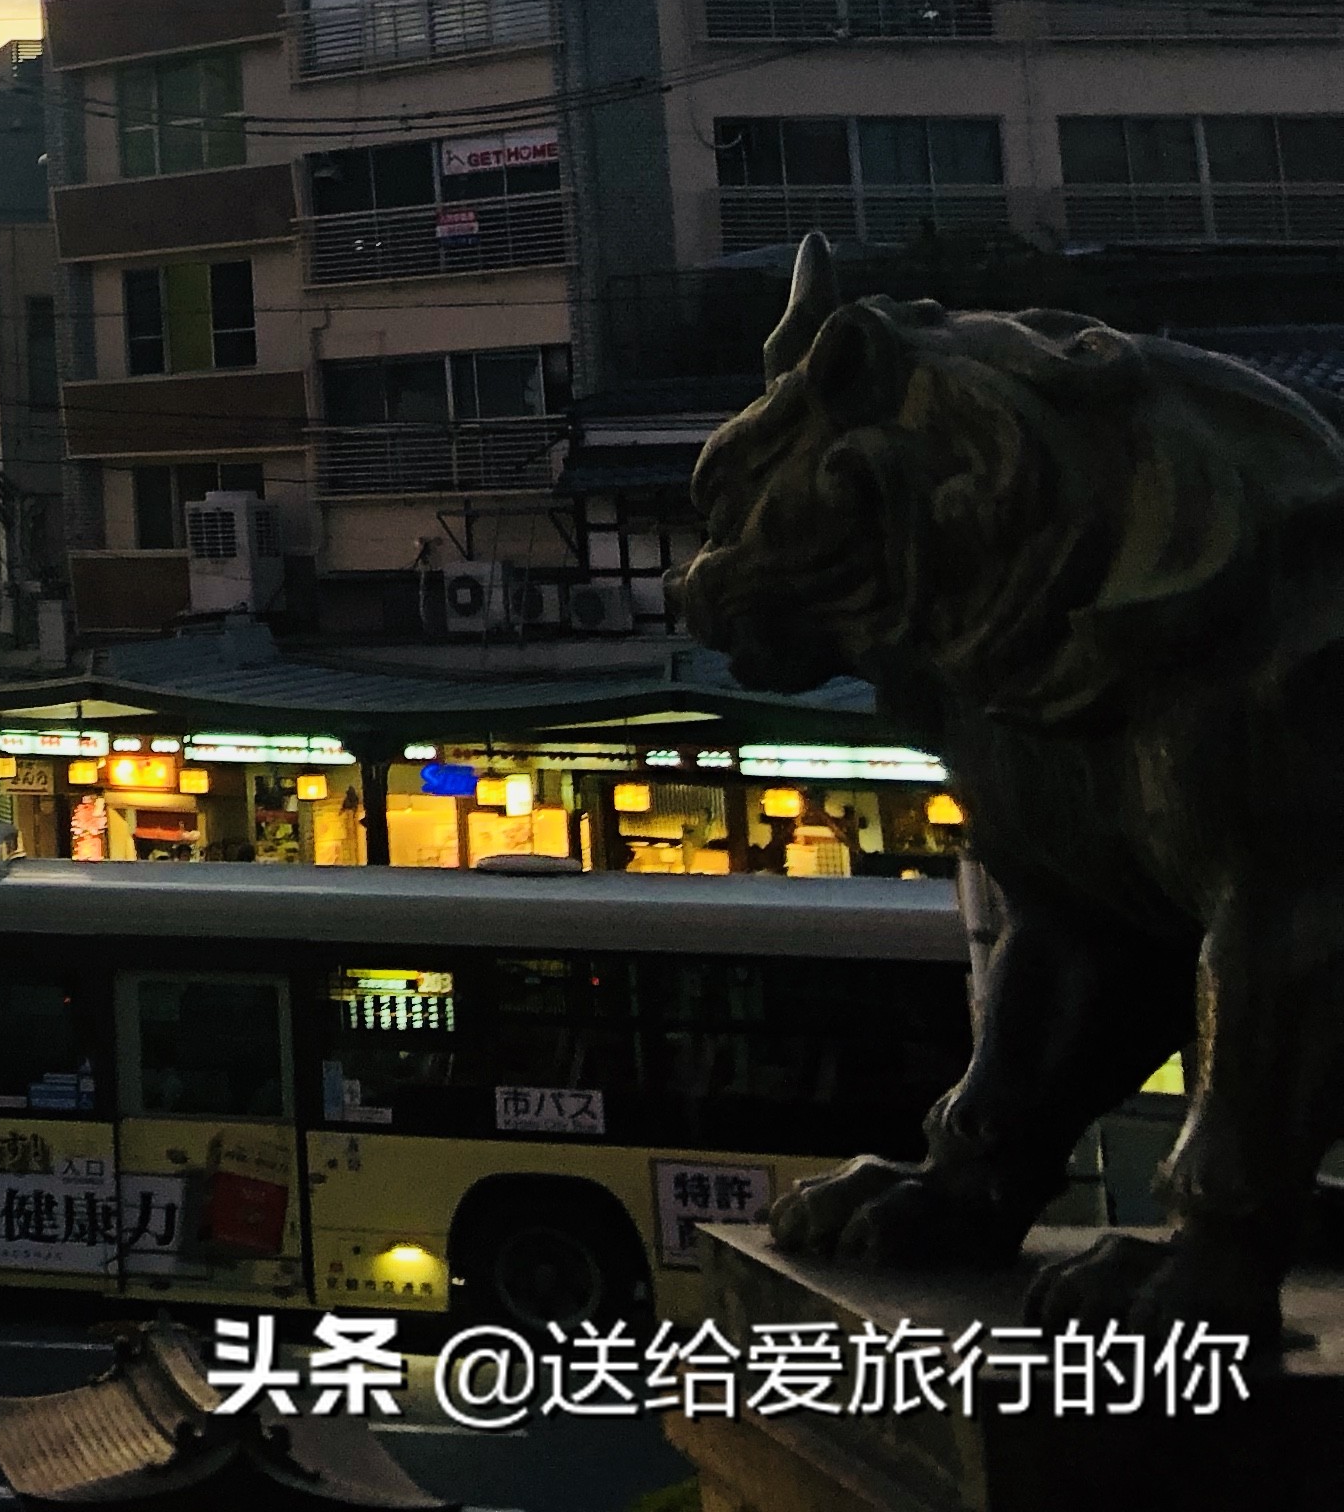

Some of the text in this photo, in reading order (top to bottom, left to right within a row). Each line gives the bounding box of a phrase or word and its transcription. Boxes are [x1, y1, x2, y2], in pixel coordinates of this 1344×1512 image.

[467, 142, 559, 168] GET HOME
[502, 1090, 598, 1120] 市バス
[62, 1158, 105, 1178] 入口
[672, 1171, 753, 1210] 特許
